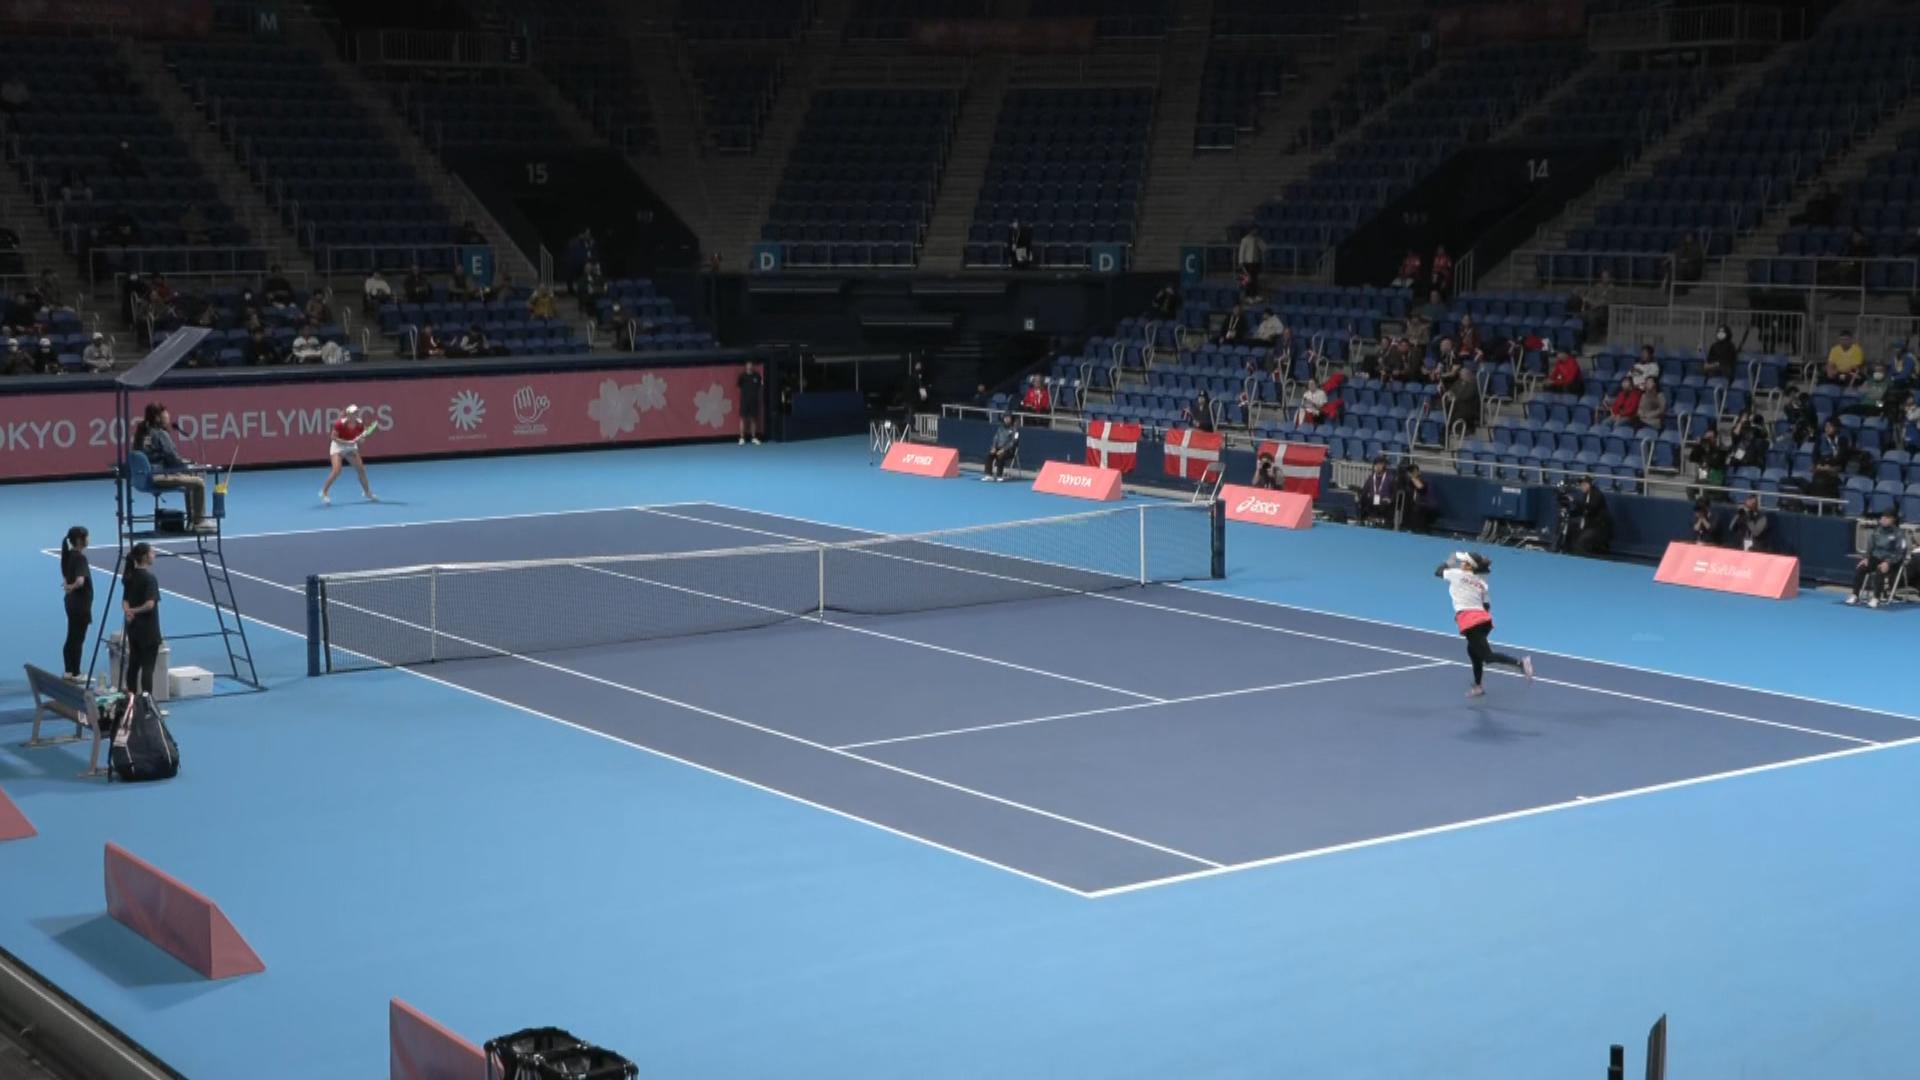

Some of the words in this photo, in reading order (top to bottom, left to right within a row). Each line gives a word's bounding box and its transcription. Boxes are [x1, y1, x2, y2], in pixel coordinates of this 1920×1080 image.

[260, 12, 277, 32] M
[526, 162, 549, 185] 15
[1526, 158, 1549, 183] 14
[472, 255, 483, 275] E
[760, 252, 775, 271] D
[1099, 253, 1114, 272] D
[1185, 254, 1196, 273] C
[0, 420, 77, 451] KYO
[177, 404, 394, 441] DEAFLYMPCS
[1057, 473, 1093, 488] TOYOTA
